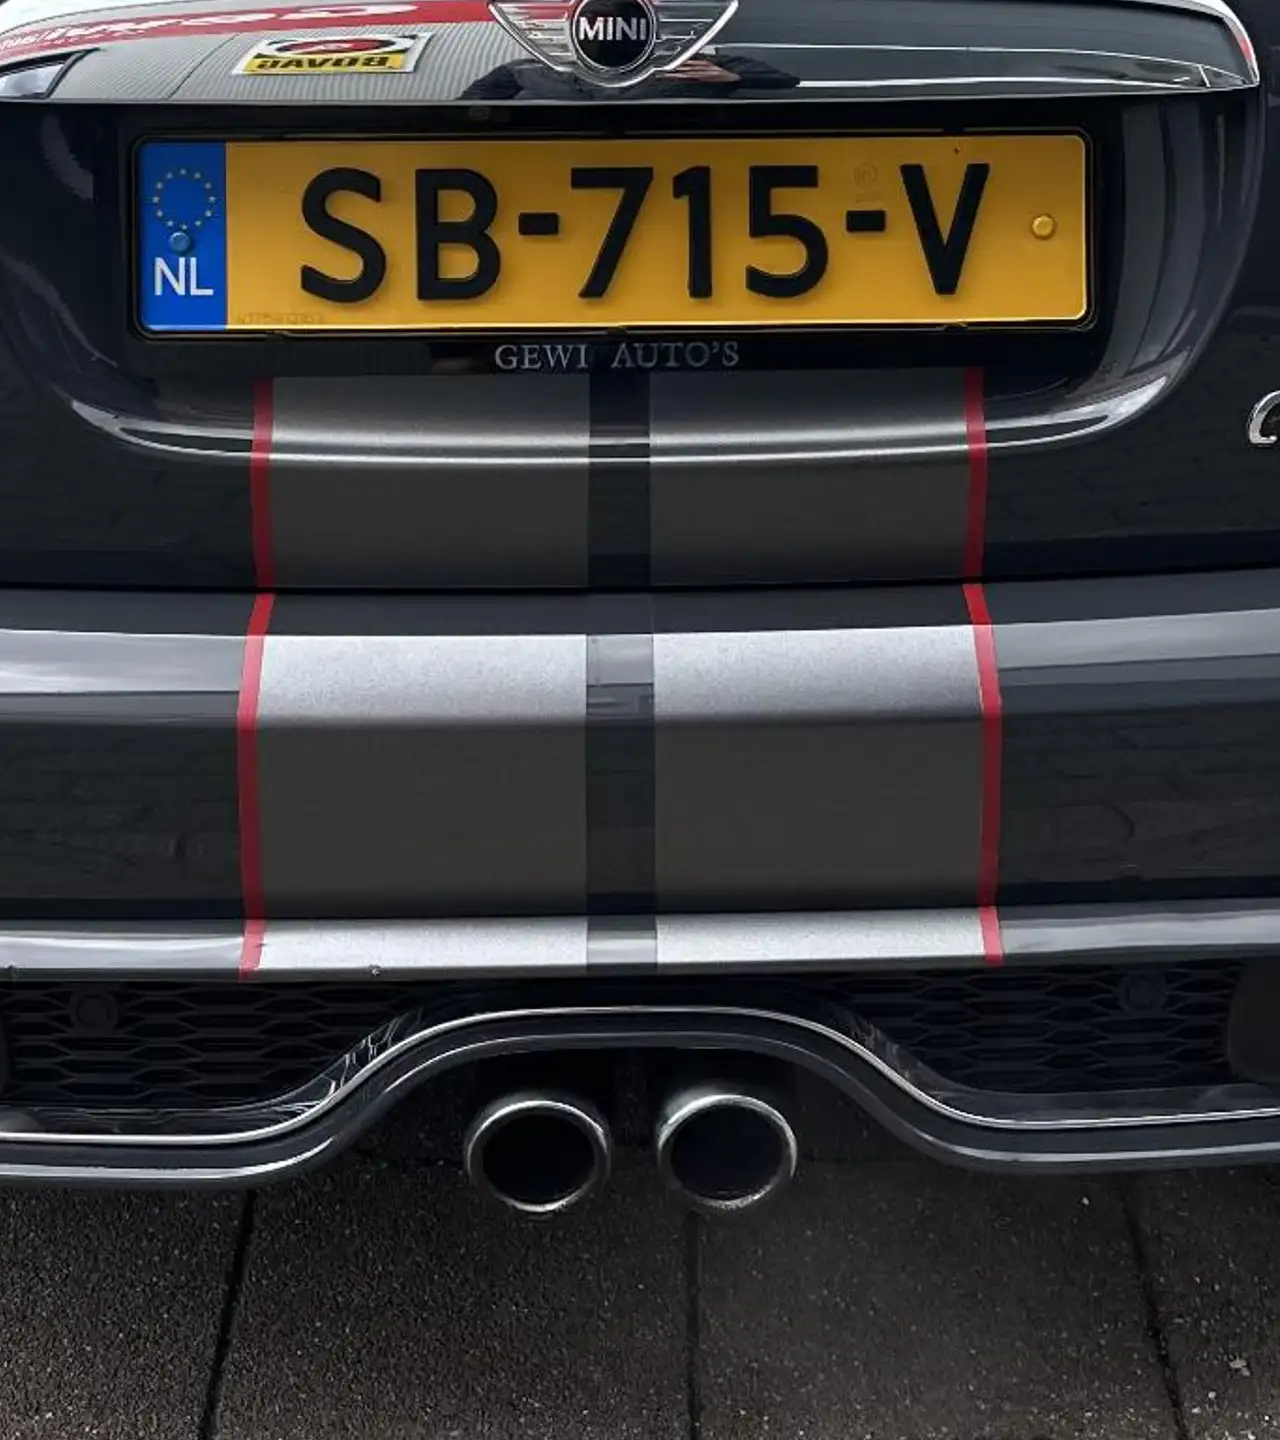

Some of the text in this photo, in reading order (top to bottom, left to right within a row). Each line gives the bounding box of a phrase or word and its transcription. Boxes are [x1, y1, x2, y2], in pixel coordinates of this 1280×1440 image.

[578, 16, 647, 42] MINI
[300, 163, 990, 304] SB-715-V
[153, 256, 215, 297] NL
[494, 340, 740, 371] GEWI AUTO'S
